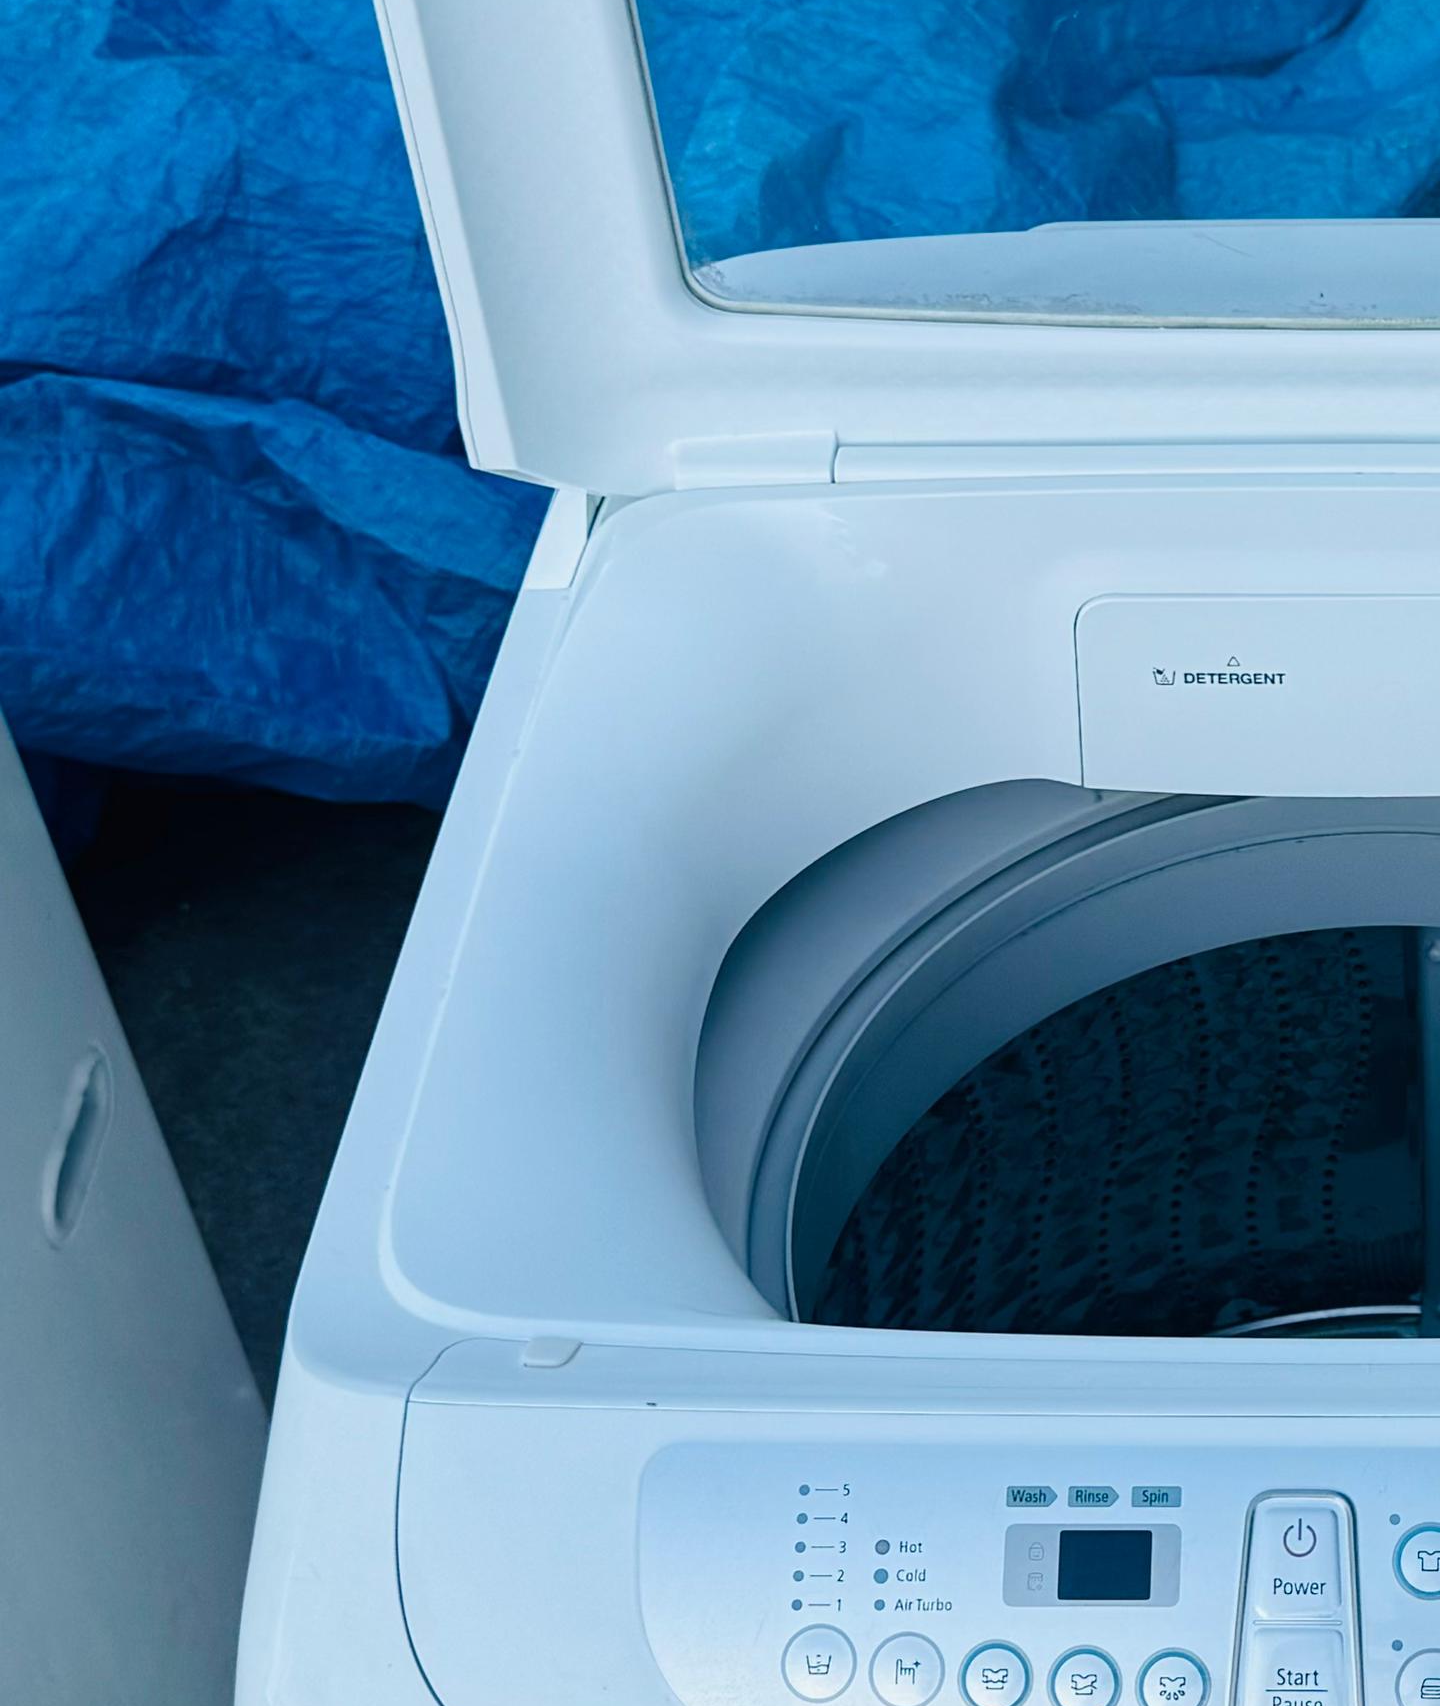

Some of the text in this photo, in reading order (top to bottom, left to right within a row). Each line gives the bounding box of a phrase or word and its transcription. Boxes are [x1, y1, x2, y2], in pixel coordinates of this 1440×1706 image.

[1183, 672, 1286, 685] DETERGENT
[842, 1483, 851, 1497] 5
[1011, 1487, 1048, 1505] Wash
[1074, 1488, 1110, 1505] Rinse
[1140, 1488, 1170, 1506] Spin
[839, 1512, 849, 1525] 4
[837, 1541, 848, 1554] 3
[899, 1540, 923, 1554] Hot
[836, 1568, 845, 1583] 2
[895, 1568, 927, 1583] Cold
[1273, 1577, 1327, 1596] Power
[835, 1599, 843, 1611] 1
[894, 1597, 953, 1612] Air Turbo
[1276, 1667, 1319, 1687] Start
